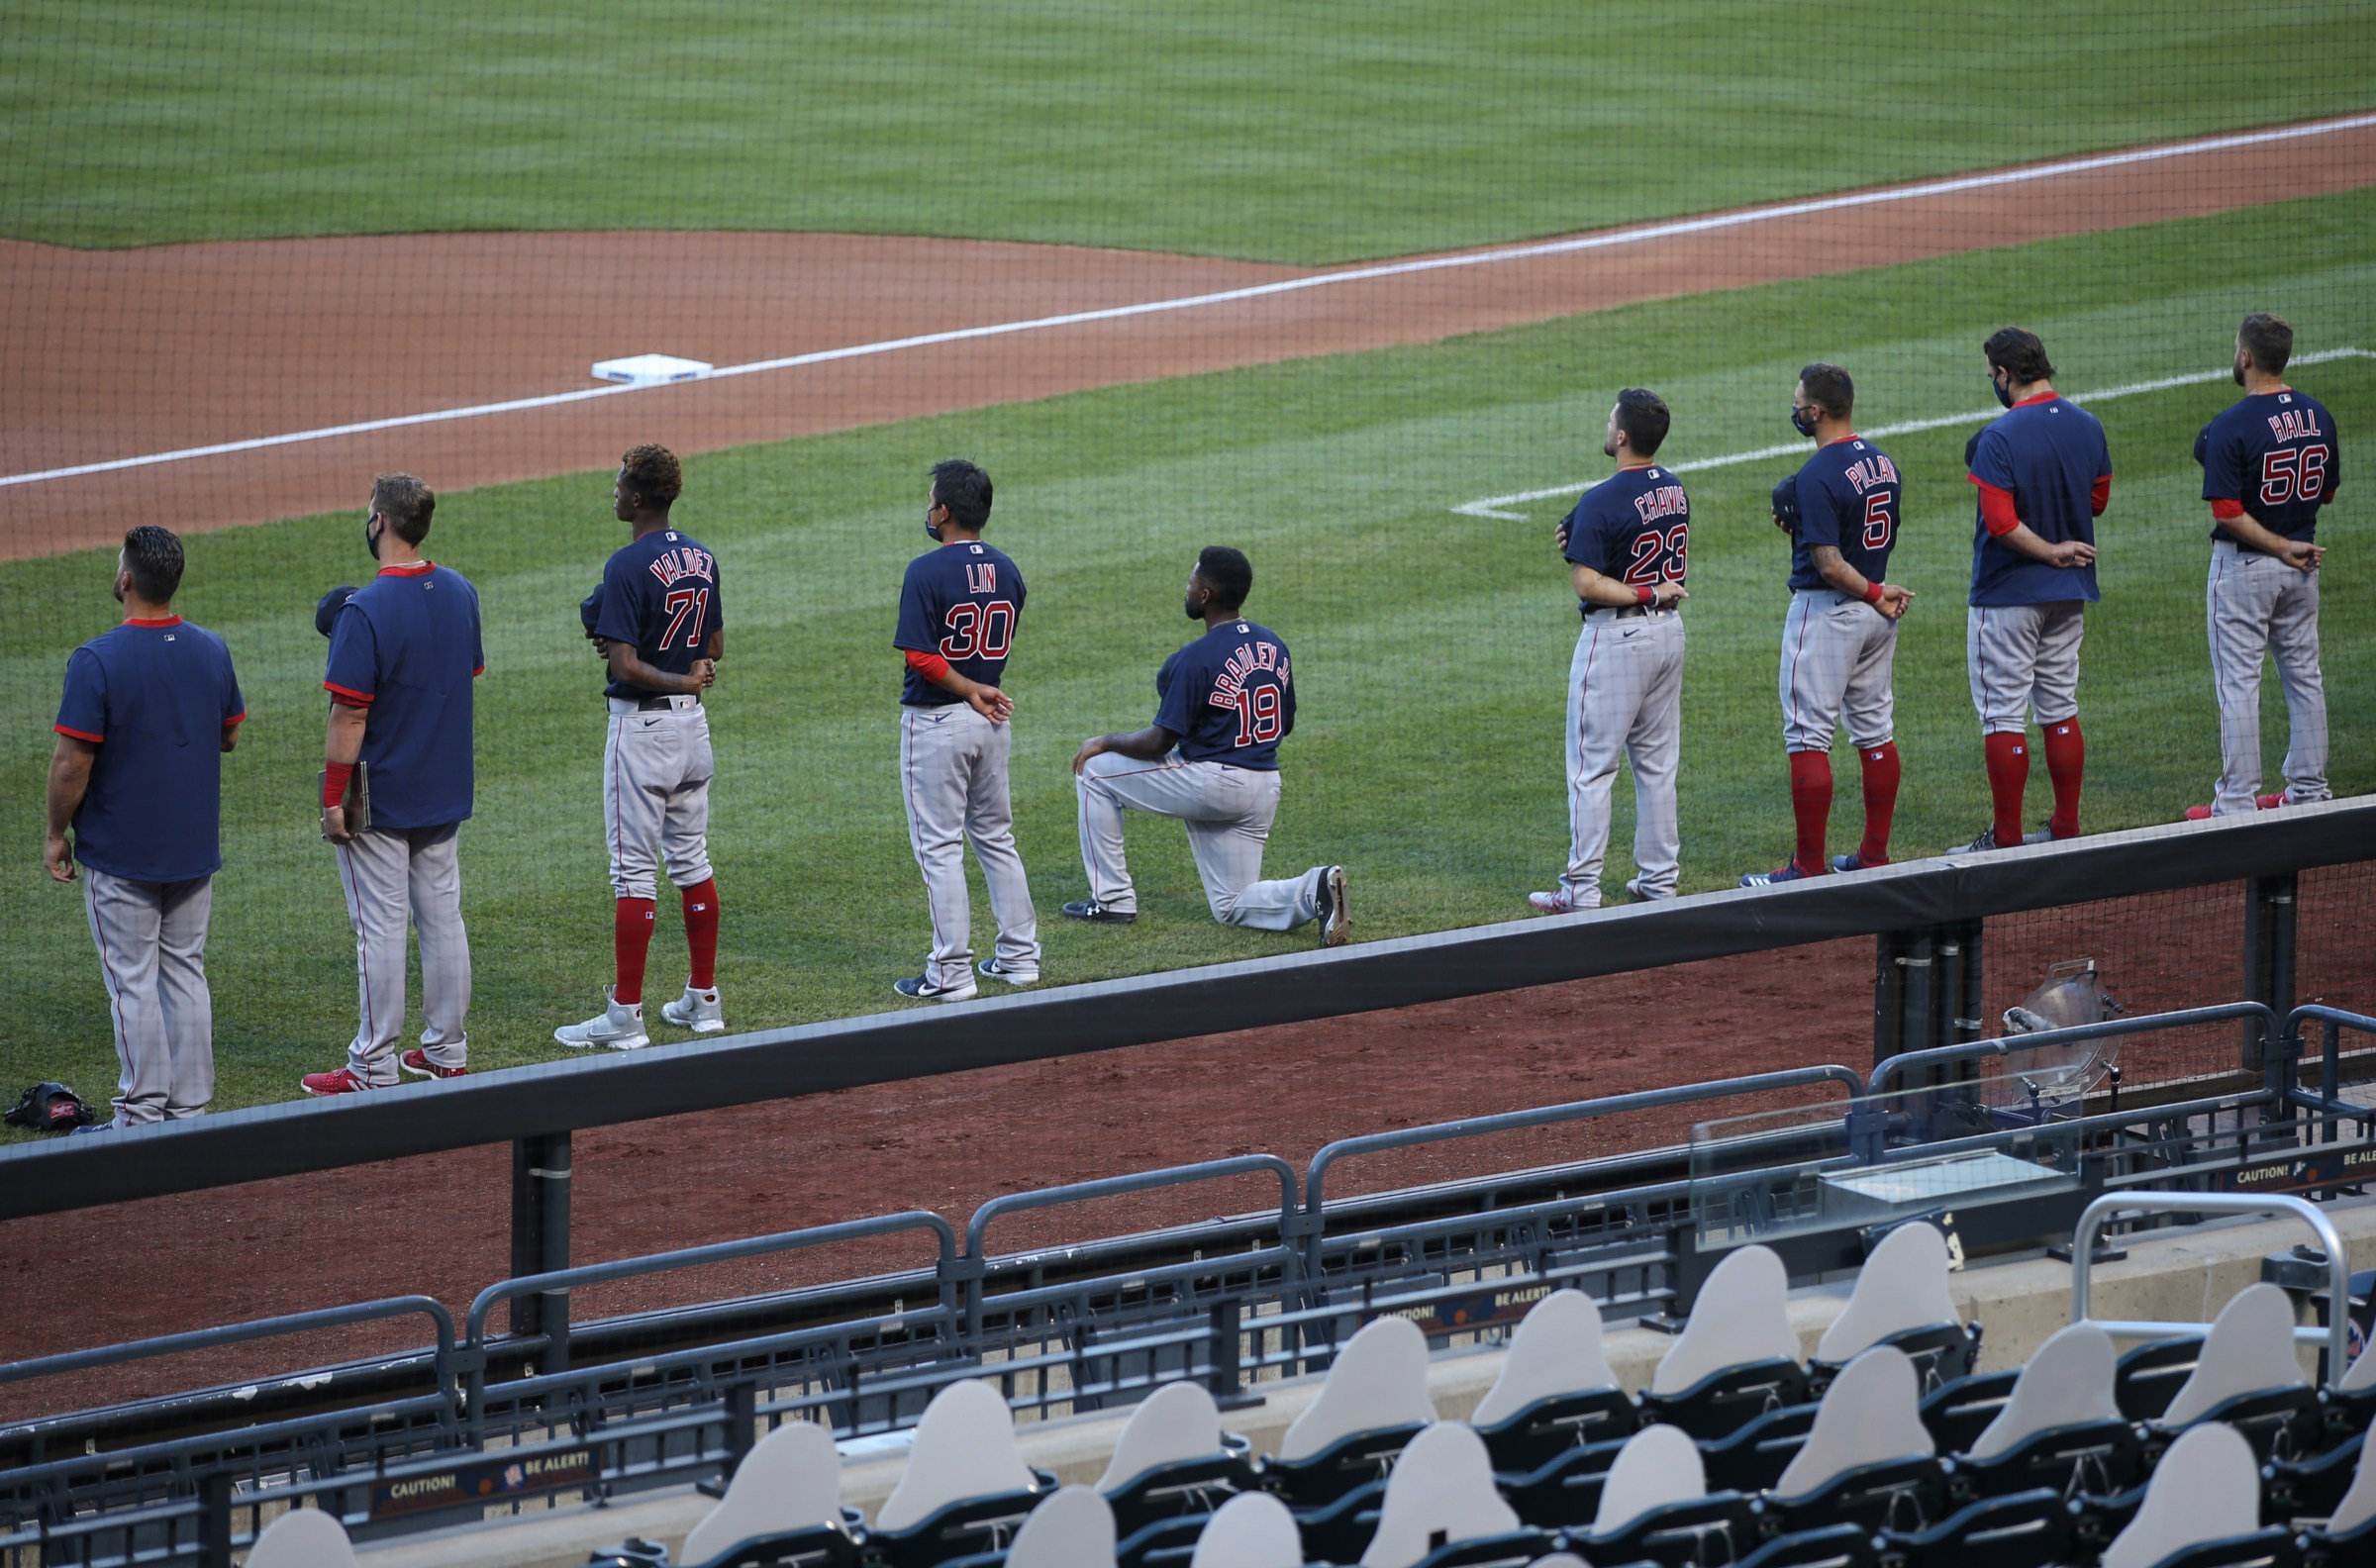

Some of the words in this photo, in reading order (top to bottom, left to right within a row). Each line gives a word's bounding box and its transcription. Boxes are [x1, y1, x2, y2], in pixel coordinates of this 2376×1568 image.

[2268, 409, 2322, 443] HALL
[2260, 443, 2329, 506] 56
[1634, 485, 1688, 525] CHAVIS
[1862, 491, 1891, 550] 5
[649, 547, 714, 588] VALDEZ
[1624, 523, 1689, 586] 23
[966, 562, 996, 594] LIN
[658, 588, 709, 651] 71
[939, 600, 1016, 660] 30
[1209, 641, 1277, 710] BRADLEY
[1235, 683, 1282, 748] 19
[2236, 1164, 2290, 1184] CAUTION!
[2343, 1152, 2357, 1166] BE
[1495, 1292, 1511, 1308] BE
[525, 1459, 542, 1475] BE
[544, 1450, 590, 1471] ALERT!
[390, 1474, 456, 1499] CAUTION!
